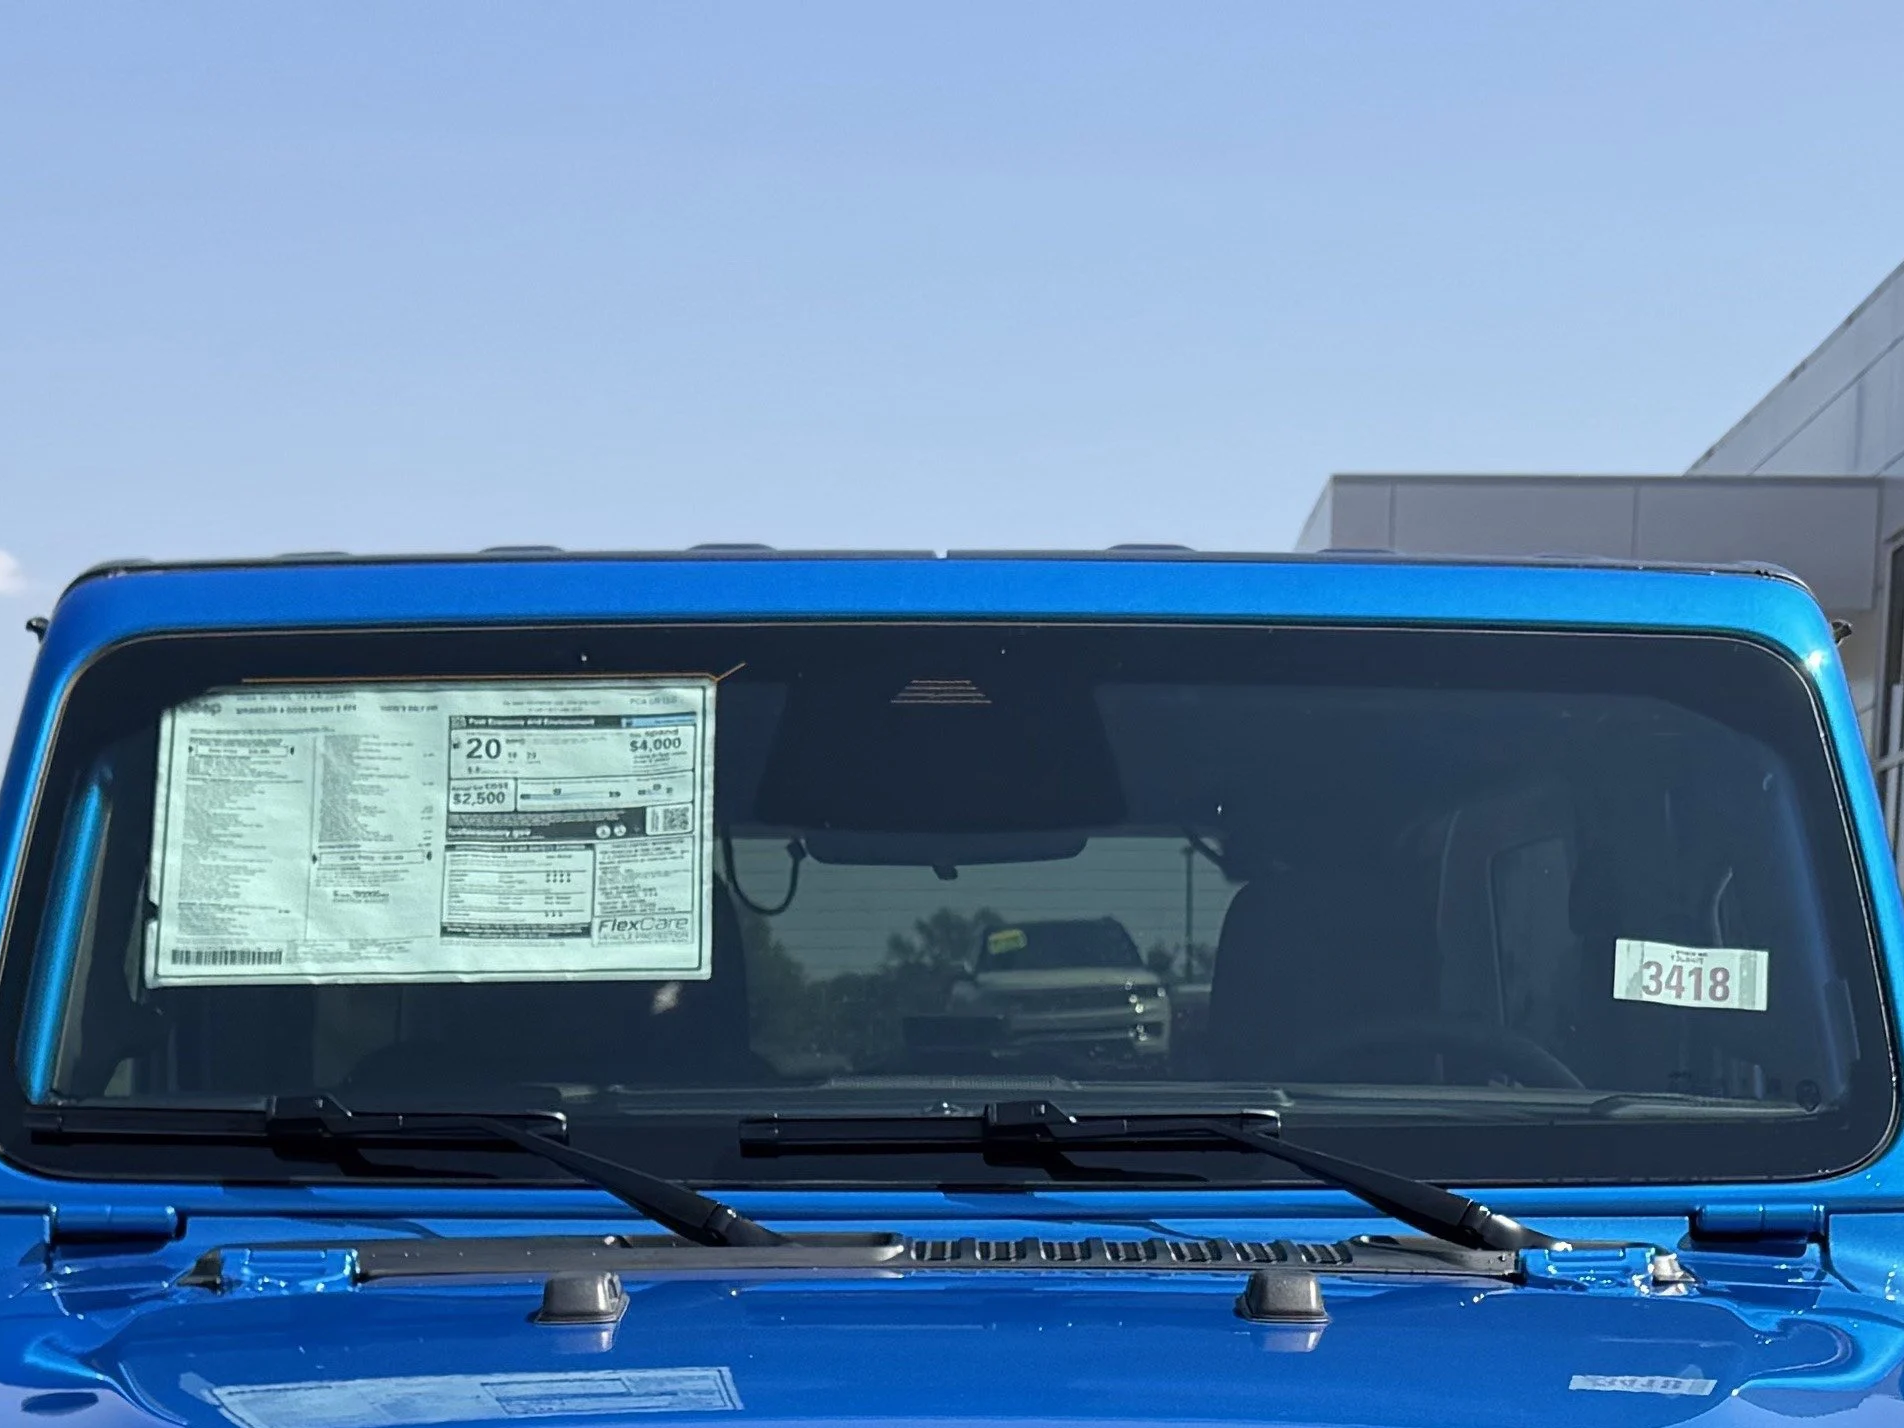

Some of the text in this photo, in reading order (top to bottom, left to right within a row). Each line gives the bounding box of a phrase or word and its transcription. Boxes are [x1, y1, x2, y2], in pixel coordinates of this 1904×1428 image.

[466, 737, 503, 760] 20
[629, 736, 682, 753] $4,000
[453, 791, 506, 806] $2,500
[598, 916, 689, 933] FlexCare
[1642, 960, 1730, 1002] 3418
